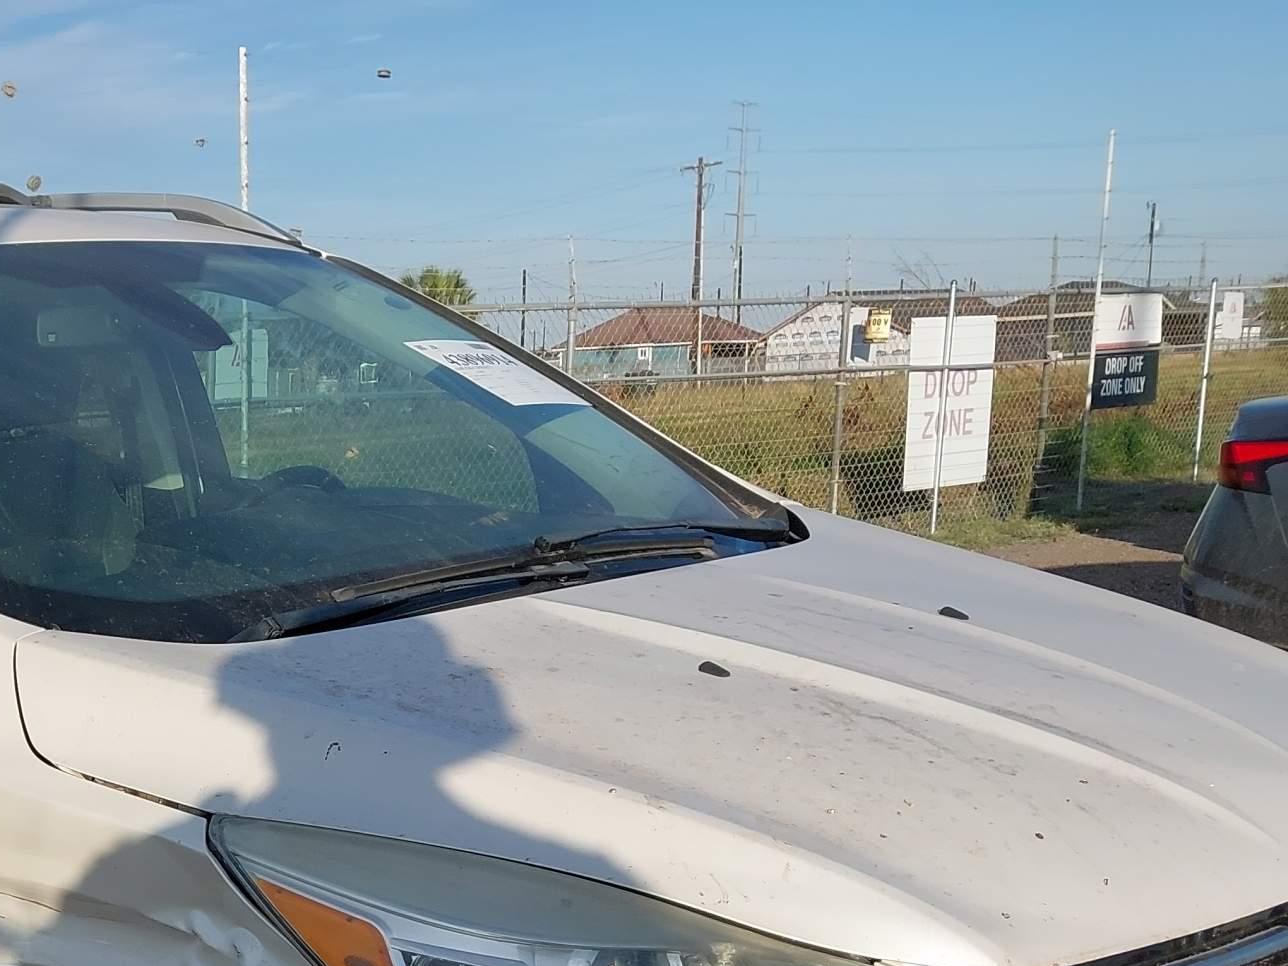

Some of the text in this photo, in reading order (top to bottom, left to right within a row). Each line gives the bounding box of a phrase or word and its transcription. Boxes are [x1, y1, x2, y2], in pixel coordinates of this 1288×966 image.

[442, 351, 519, 367] 43896914
[1105, 355, 1144, 375] DROP OFF
[1100, 376, 1146, 396] ZONE ONLY
